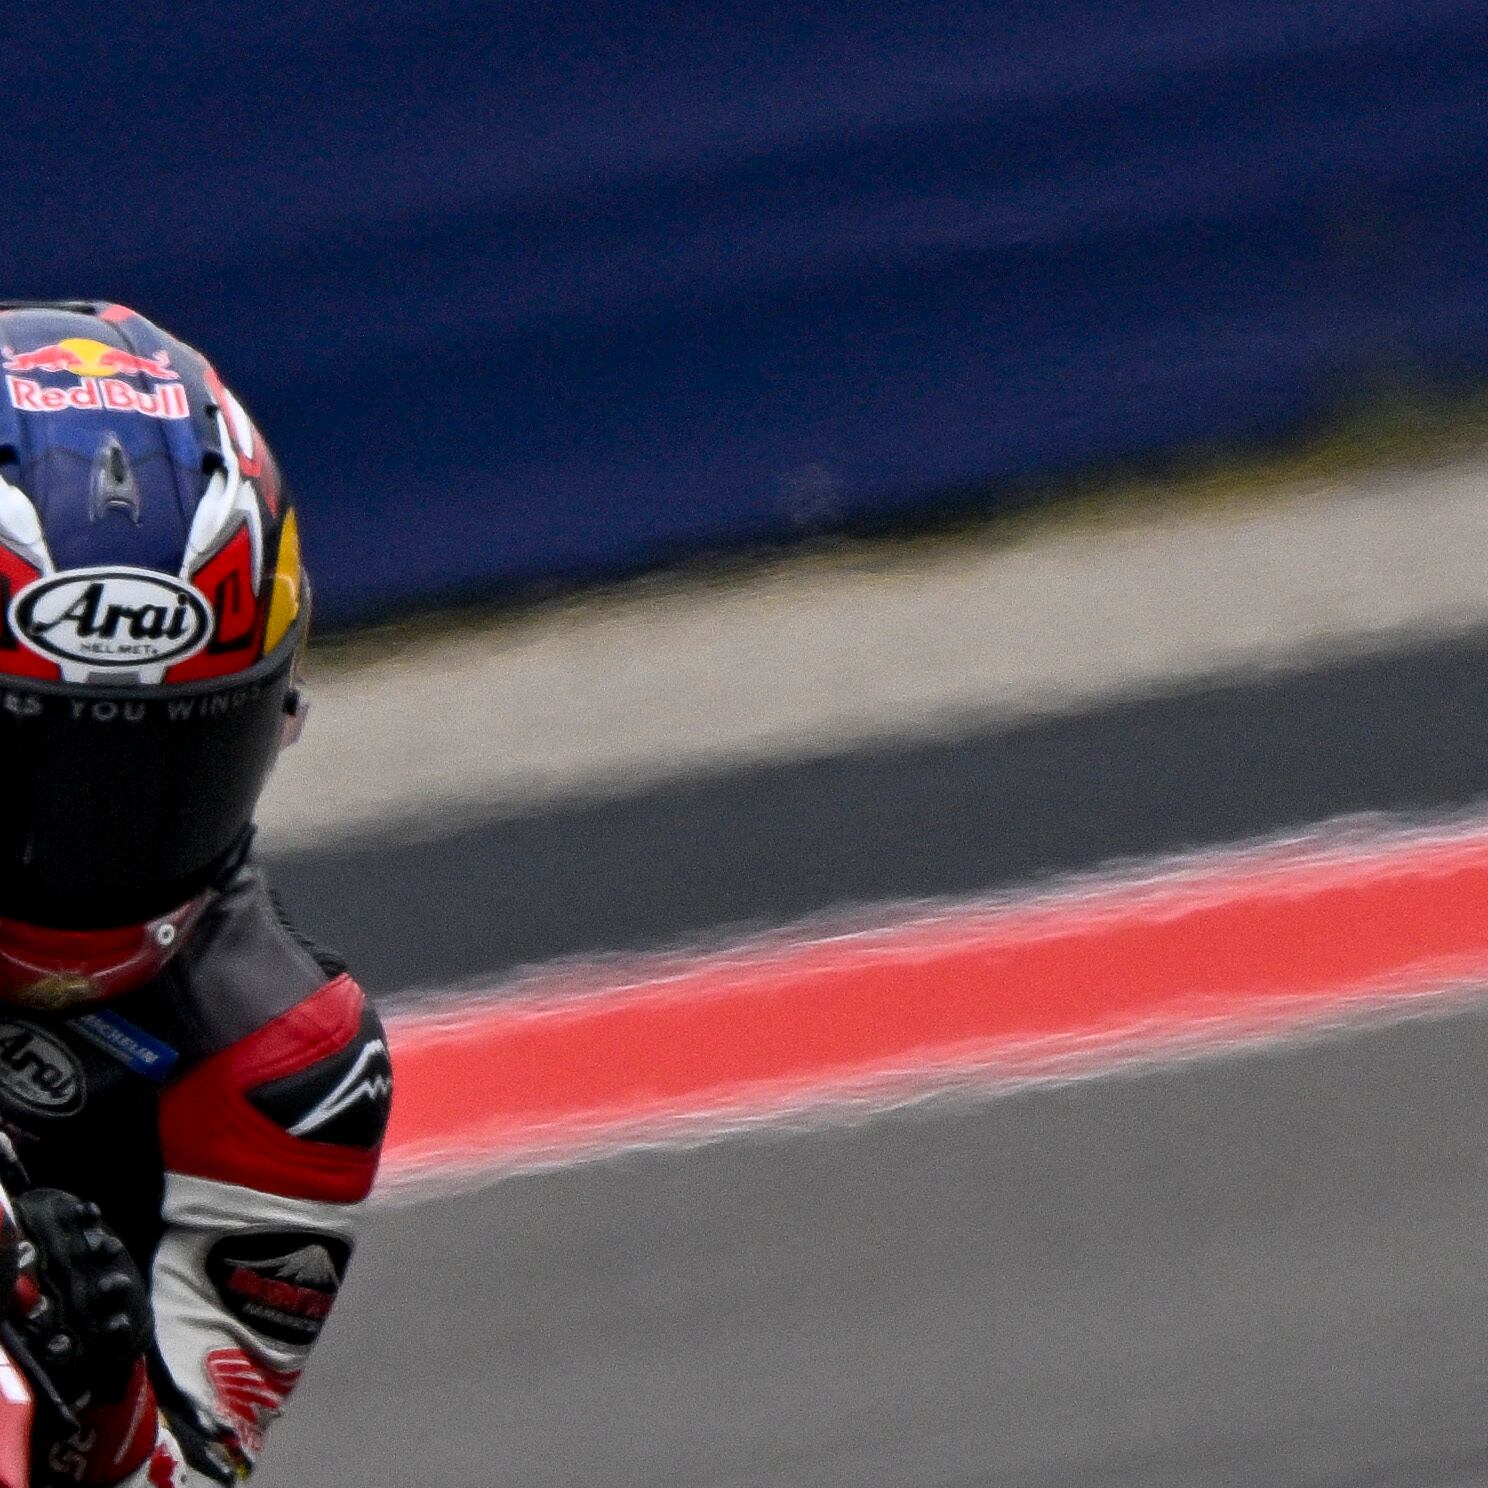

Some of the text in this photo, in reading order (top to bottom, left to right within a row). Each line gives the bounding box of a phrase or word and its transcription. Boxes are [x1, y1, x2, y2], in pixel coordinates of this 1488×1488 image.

[7, 375, 190, 419] Red Bull
[28, 582, 189, 640] Arai
